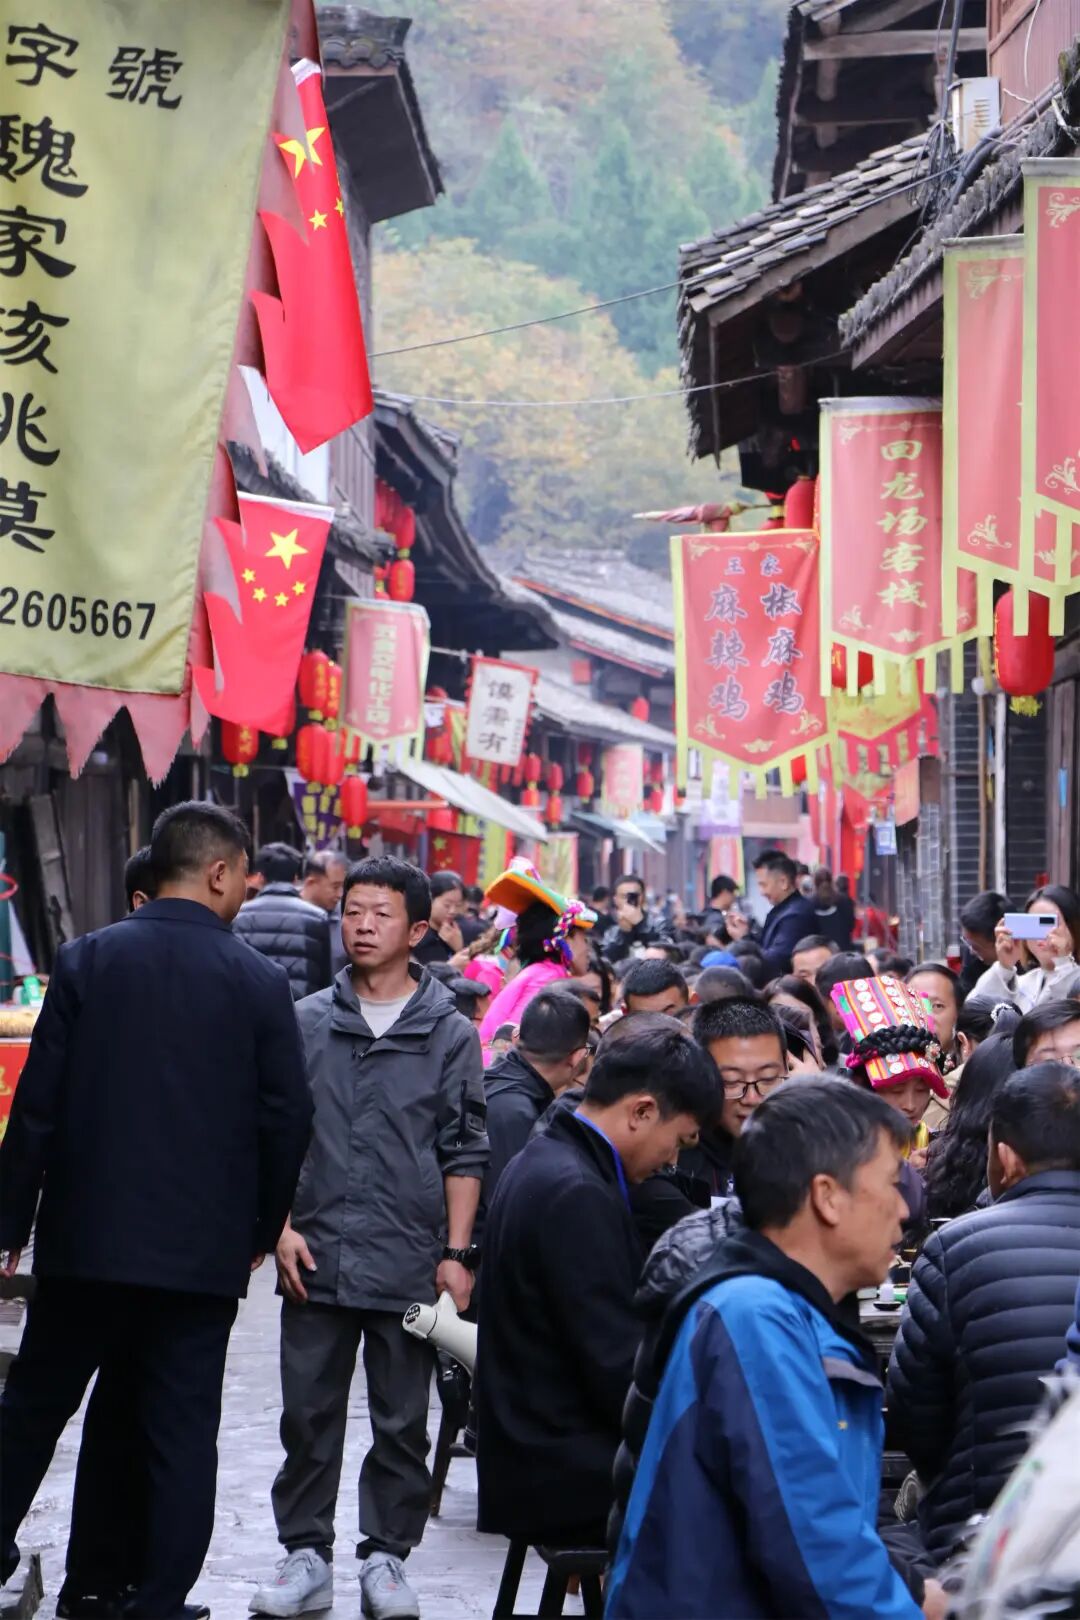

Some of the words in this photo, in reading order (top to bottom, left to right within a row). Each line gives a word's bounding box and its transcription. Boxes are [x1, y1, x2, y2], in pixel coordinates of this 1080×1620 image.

[878, 440, 928, 608] 回龙场客栈
[0, 586, 156, 641] 2605667
[705, 582, 749, 722] 麻辣鸡
[760, 583, 803, 715] 椒麻鸡
